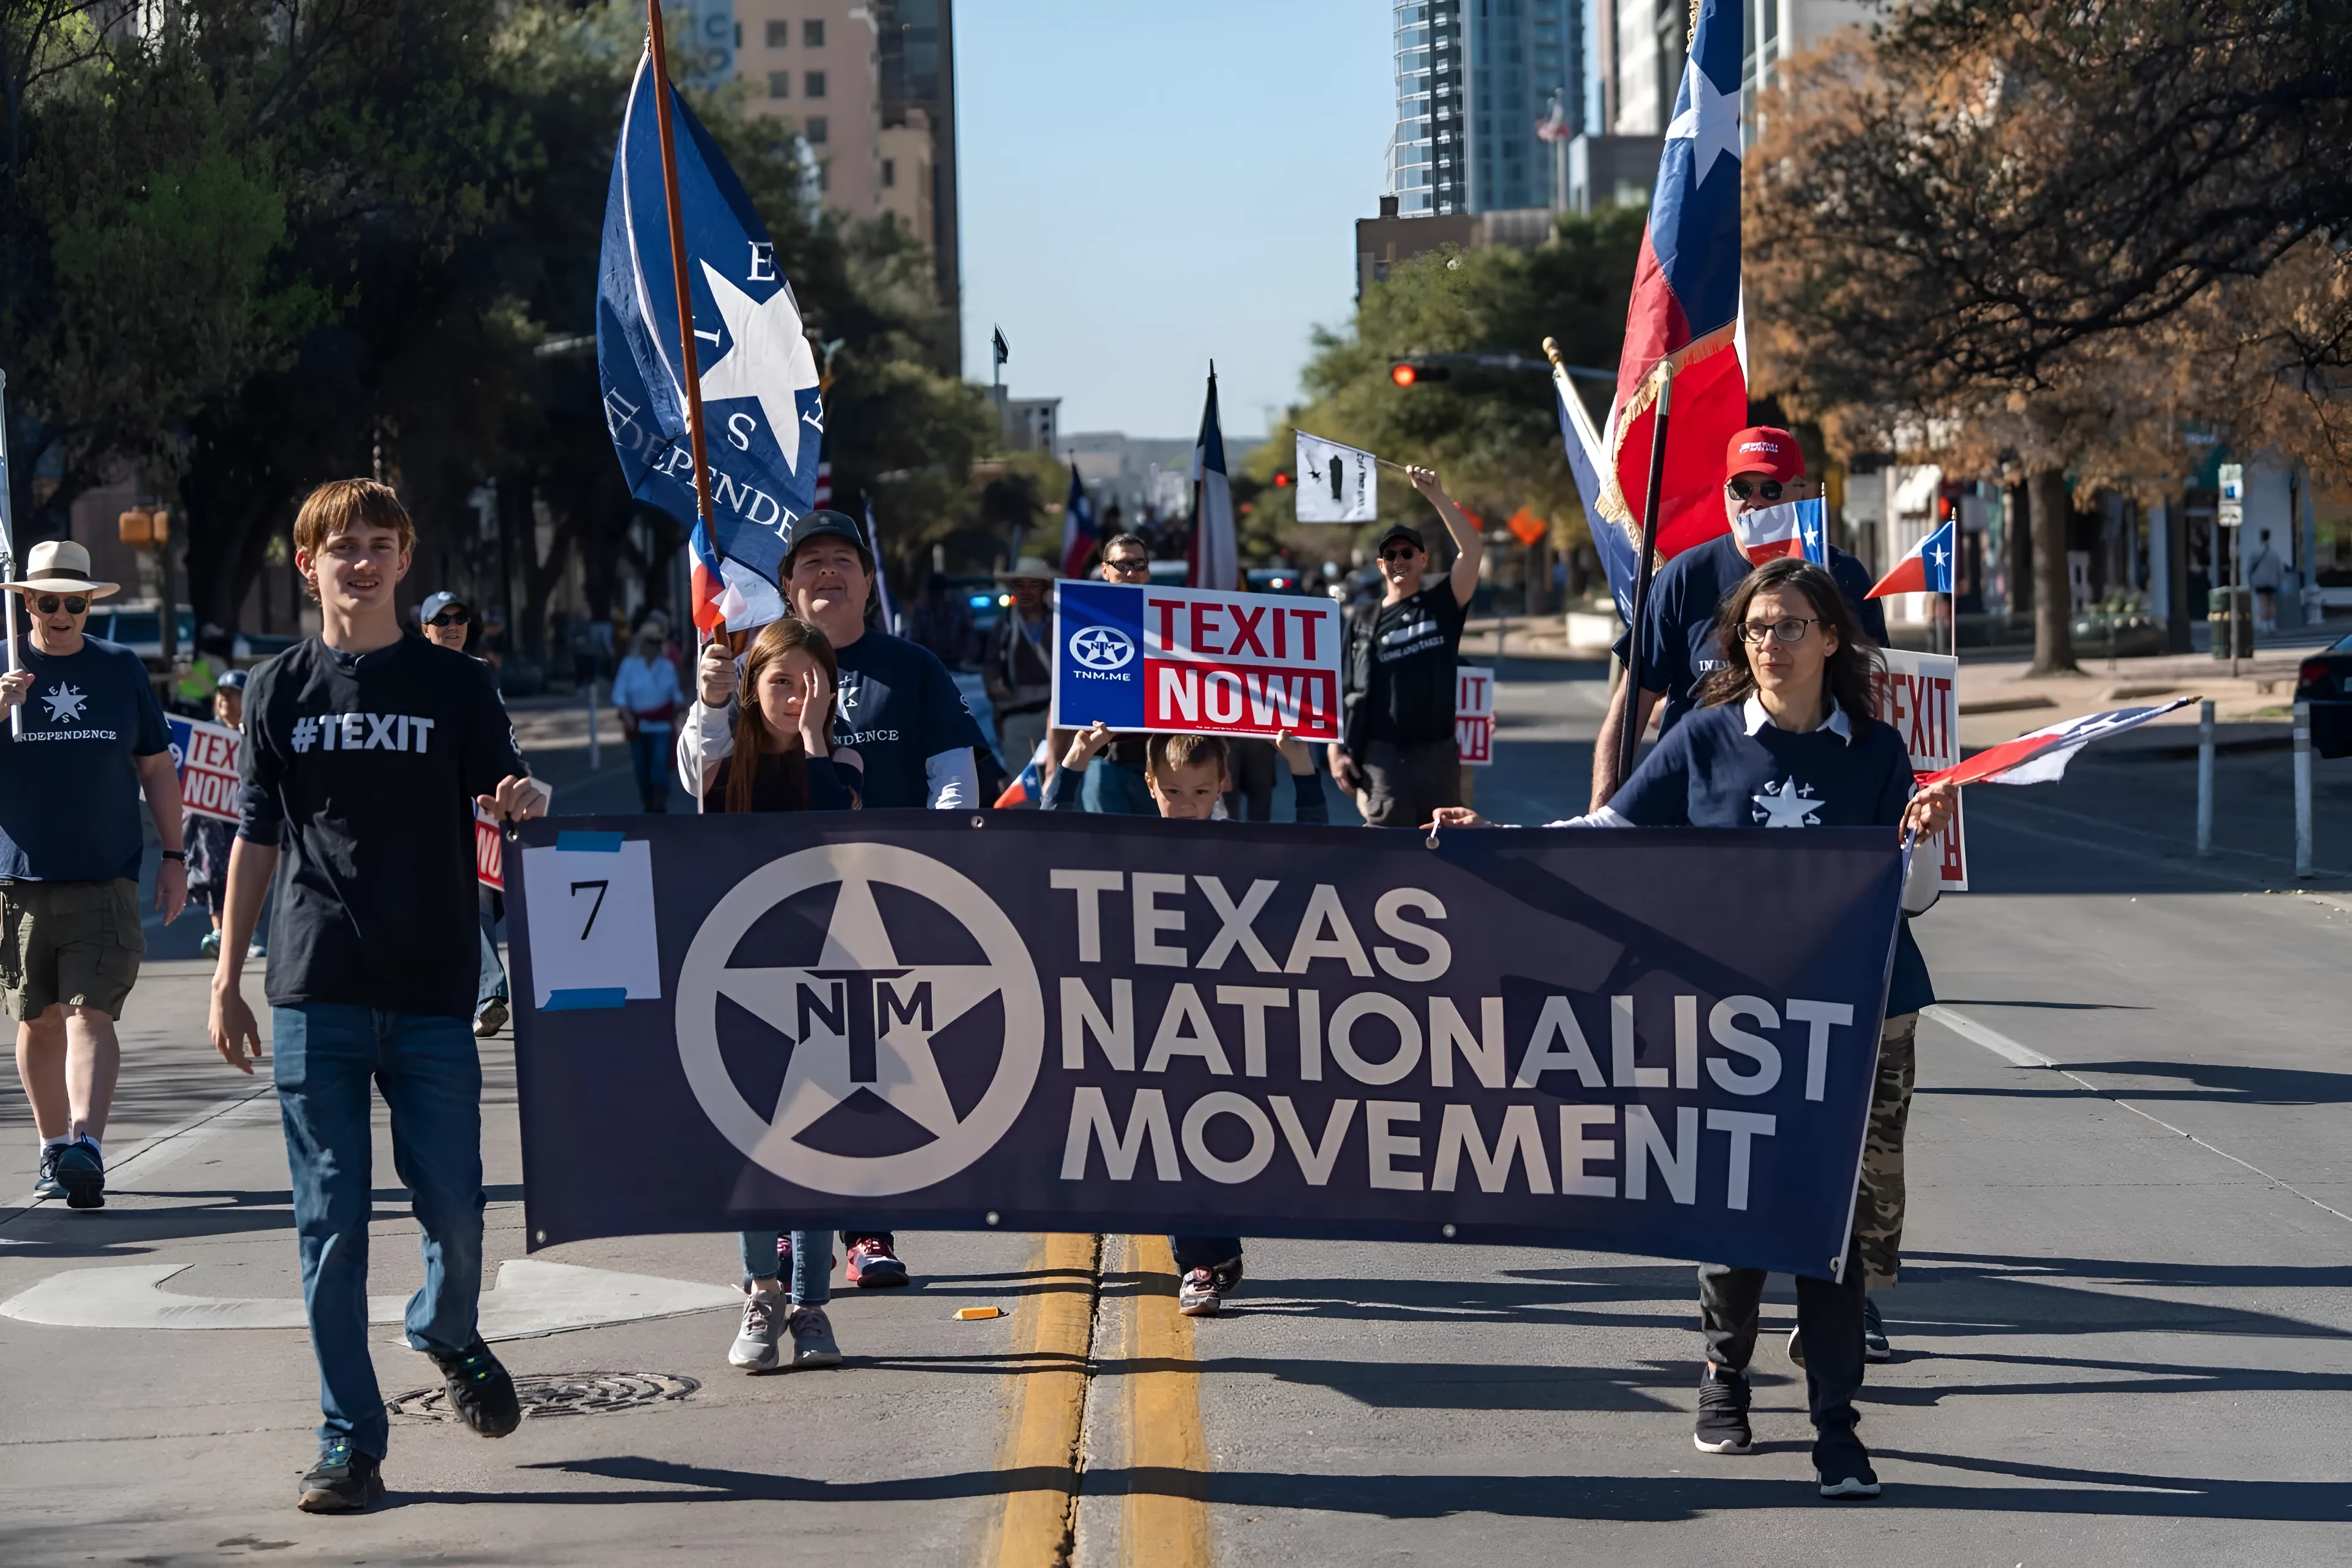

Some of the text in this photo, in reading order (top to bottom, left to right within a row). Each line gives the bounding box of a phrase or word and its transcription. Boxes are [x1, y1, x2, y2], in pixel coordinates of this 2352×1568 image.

[1148, 598, 1327, 661] TEXIT
[1073, 670, 1131, 681] TNM.ME
[1159, 667, 1325, 729] NOW!
[21, 729, 116, 742] NDEPENDENCE
[193, 730, 239, 771] TEX
[291, 713, 434, 753] #TEXIT
[833, 730, 899, 745] NDENCE
[184, 769, 239, 813] NOW
[570, 880, 608, 940] 7
[1050, 869, 1452, 982] TEXAS
[796, 968, 933, 1083] NTM
[1060, 977, 1854, 1101] NATIONALIST
[1060, 1086, 1776, 1211] MOVEMENT
